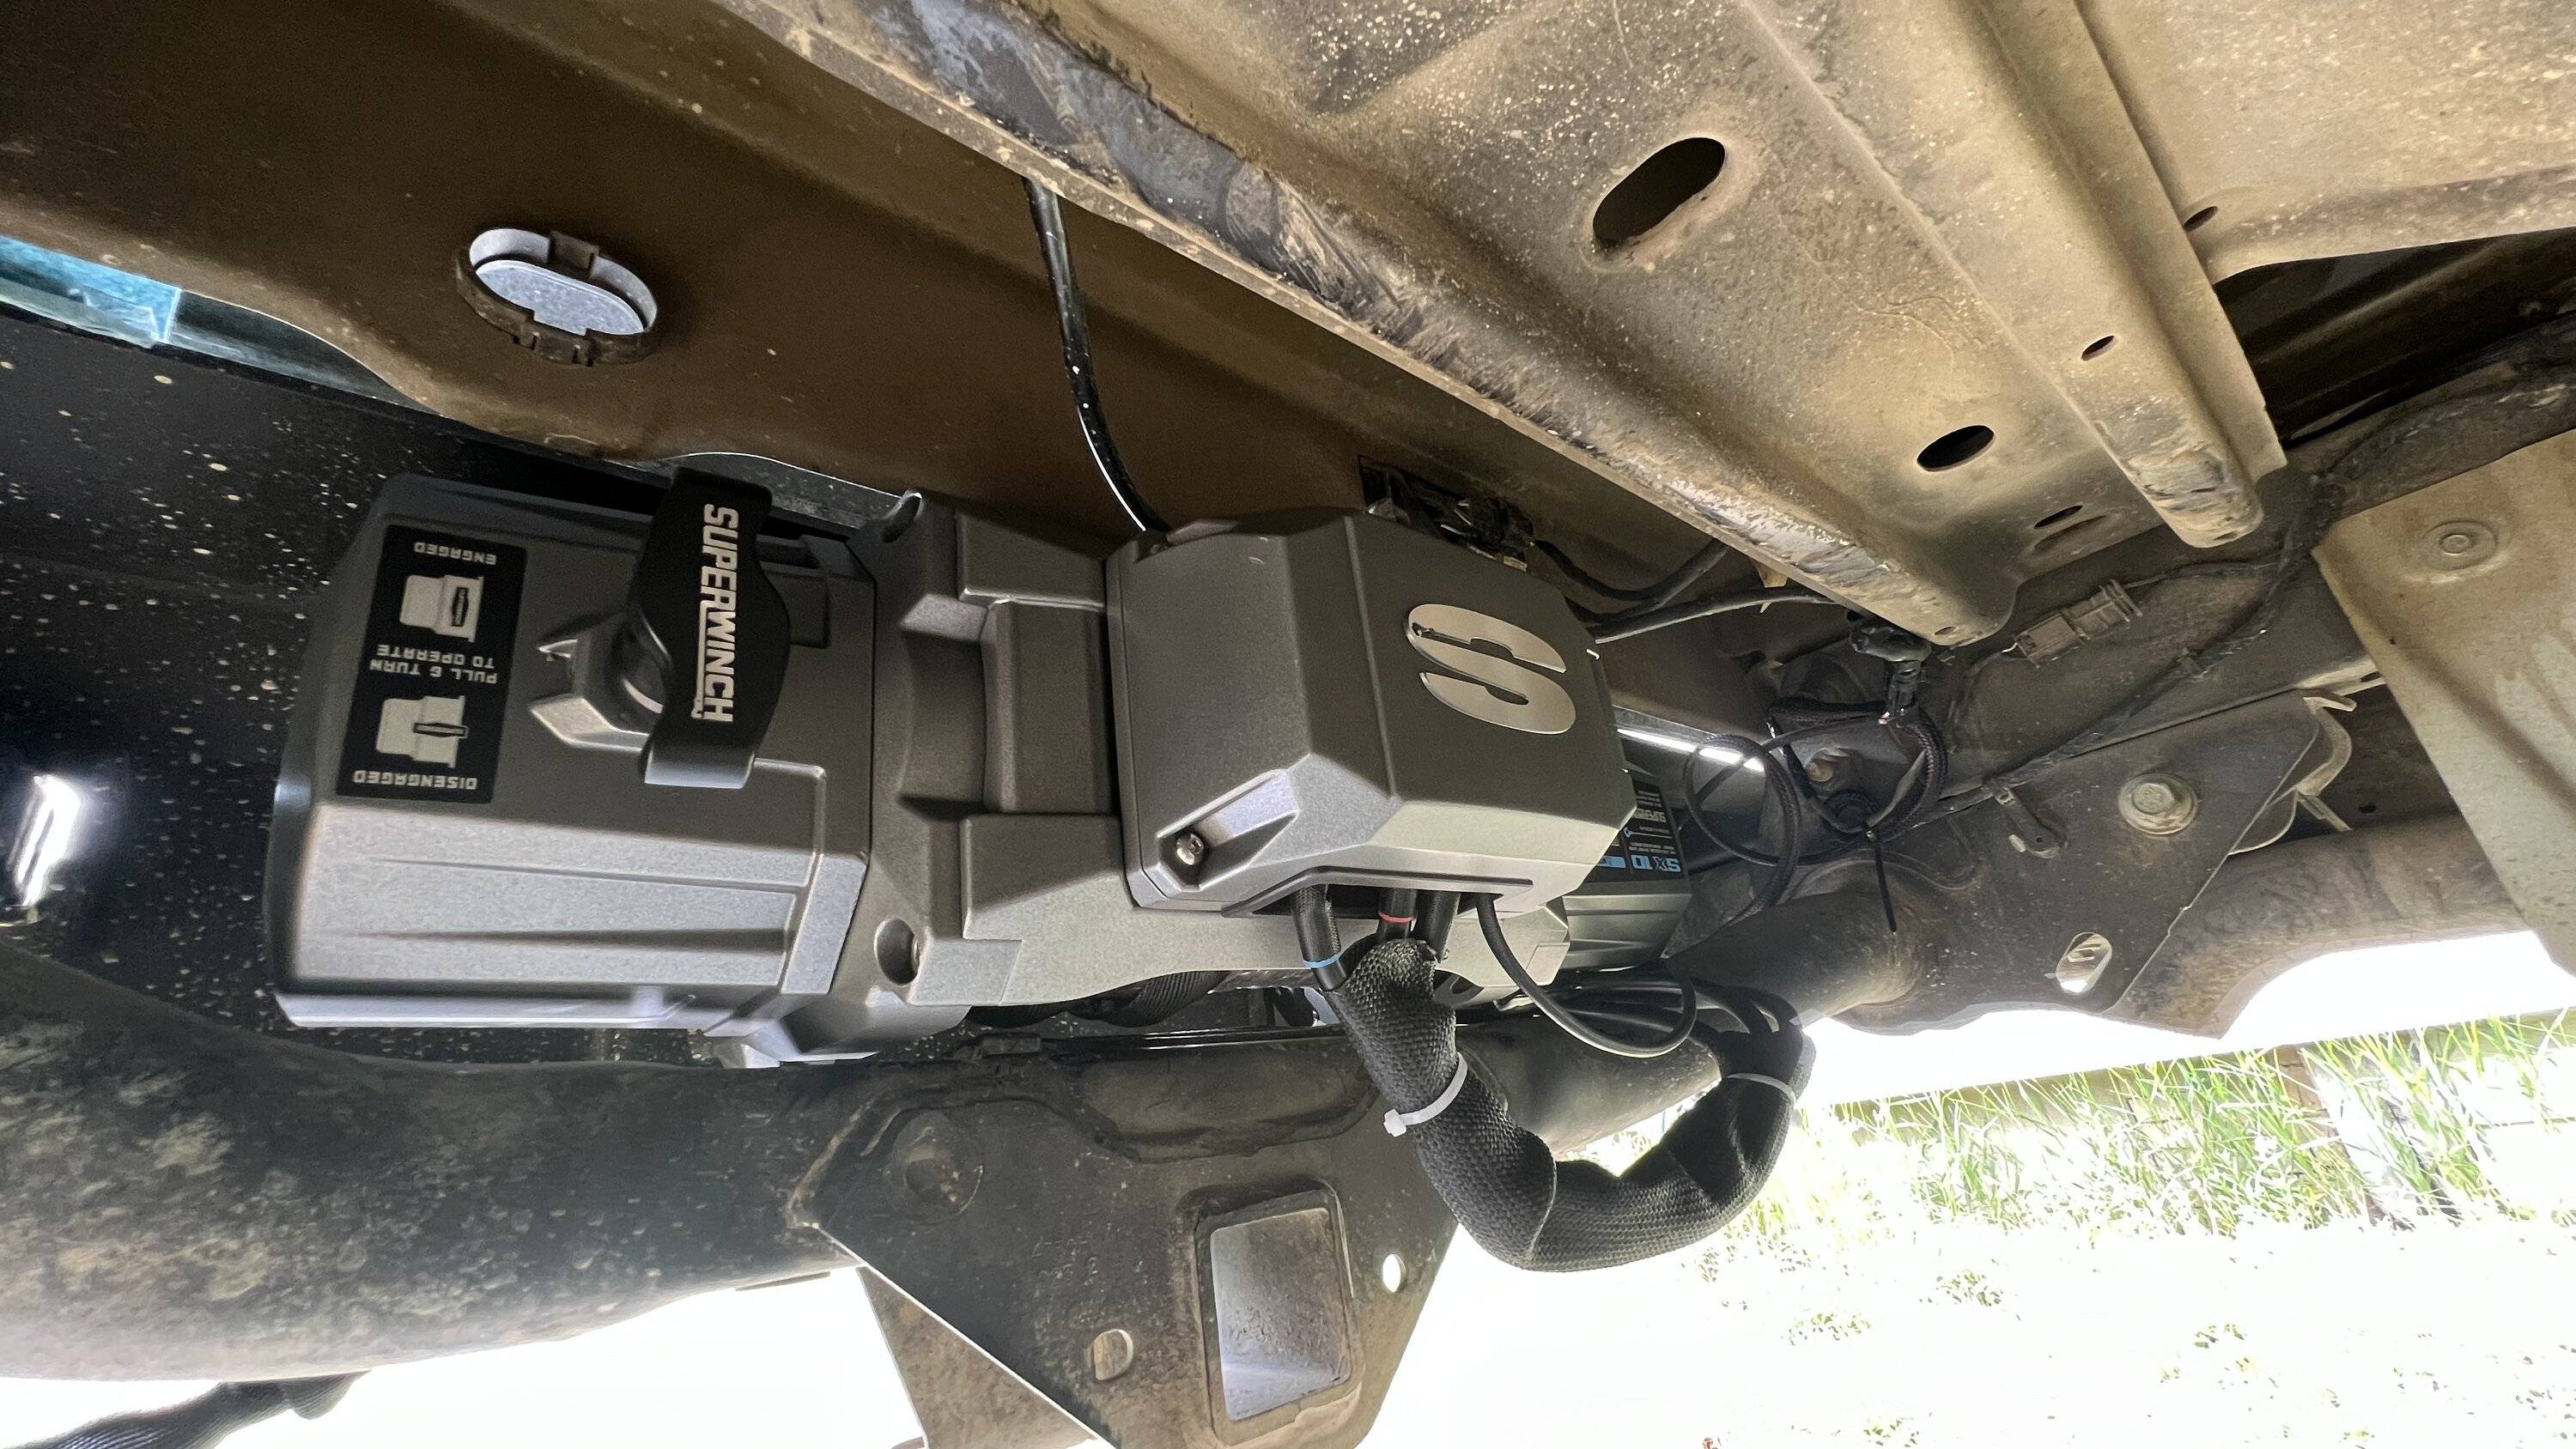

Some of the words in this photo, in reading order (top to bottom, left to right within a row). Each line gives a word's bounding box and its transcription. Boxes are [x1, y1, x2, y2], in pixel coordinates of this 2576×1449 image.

[413, 542, 497, 566] ENGAGED
[690, 503, 739, 722] SUPERWINCH
[376, 644, 465, 666] OPERATE
[472, 655, 495, 670] TO
[369, 658, 422, 676] TURN
[451, 667, 498, 684] PULL
[1405, 603, 1577, 735] S
[352, 770, 478, 790] DISENGAGED
[1631, 854, 1681, 872] SX10
